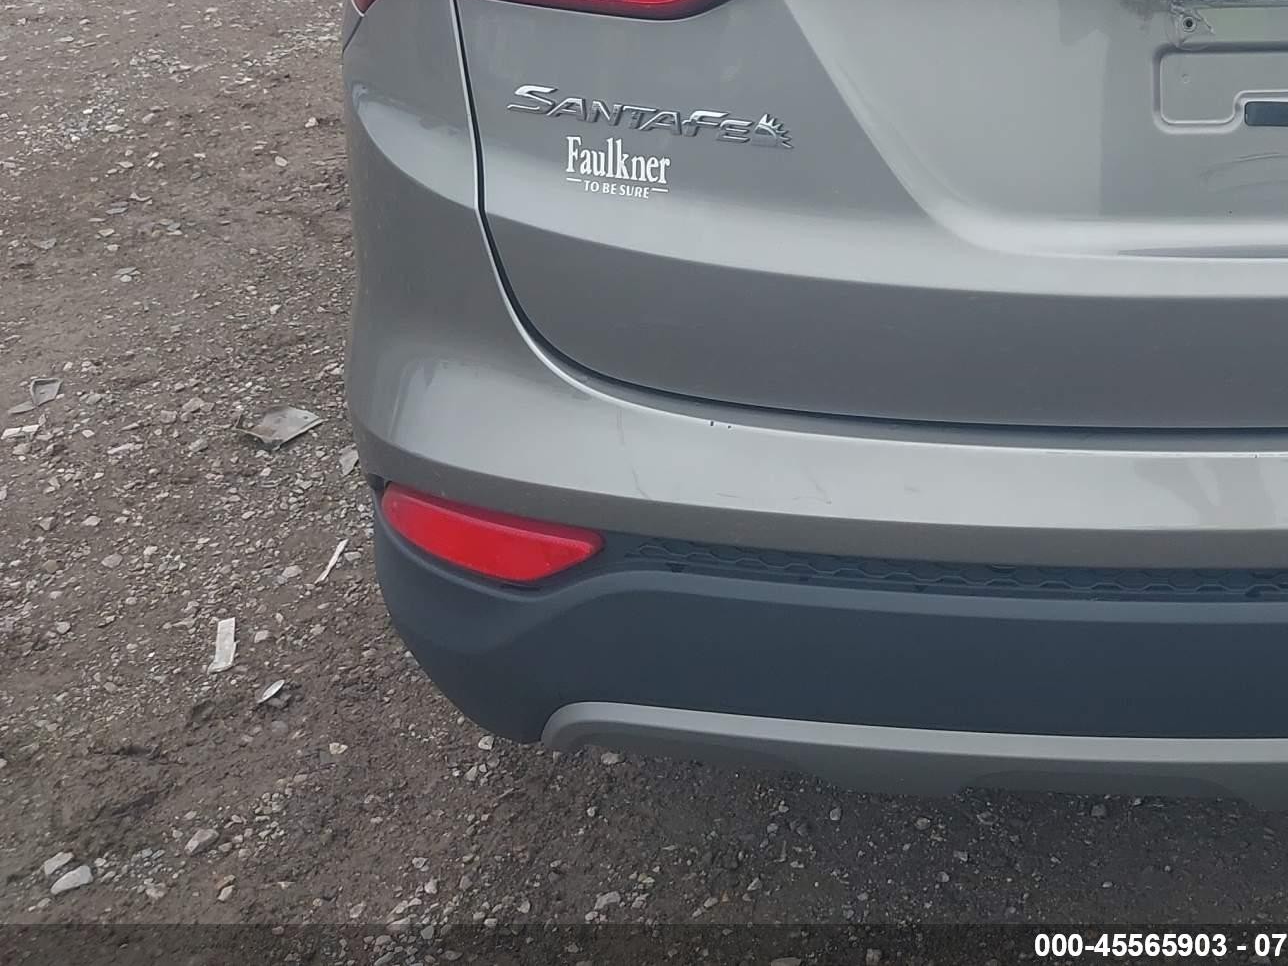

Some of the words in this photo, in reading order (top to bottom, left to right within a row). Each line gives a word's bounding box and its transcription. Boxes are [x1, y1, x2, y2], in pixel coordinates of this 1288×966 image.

[566, 136, 671, 184] Faulkner
[583, 179, 599, 193] TO
[602, 183, 617, 195] BE
[619, 185, 650, 199] SURE
